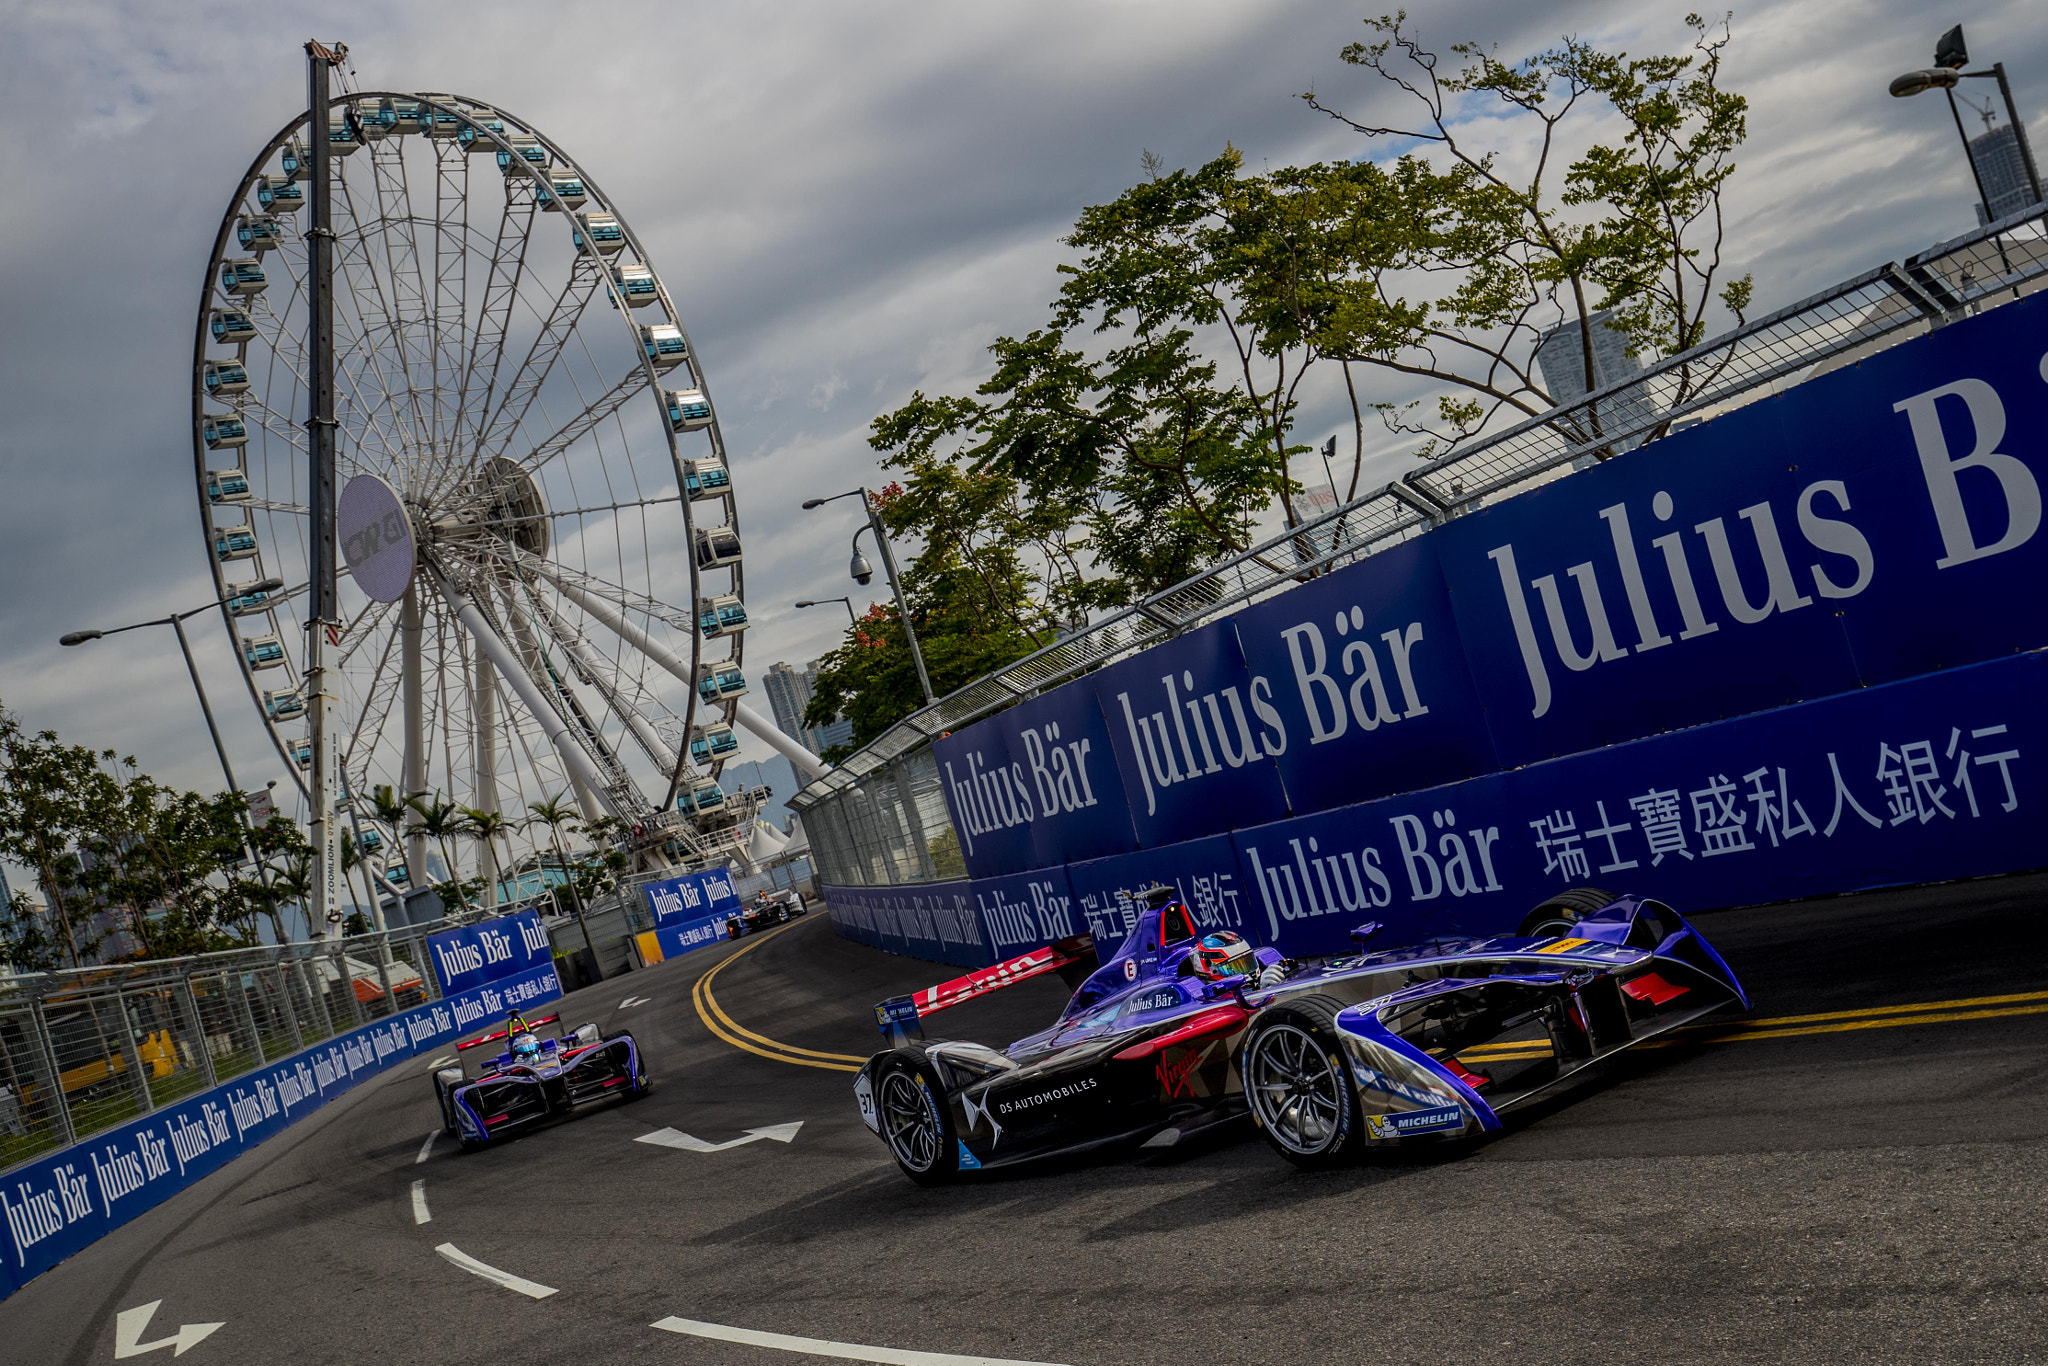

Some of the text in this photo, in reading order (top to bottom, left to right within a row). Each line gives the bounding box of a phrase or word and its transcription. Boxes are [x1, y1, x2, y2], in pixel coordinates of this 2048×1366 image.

[1308, 490, 1336, 507] UBS
[1487, 352, 2048, 718] Julius B
[1117, 605, 1430, 816] Julius Bär
[944, 721, 1098, 856] Julius Bär
[1529, 723, 2020, 883] 瑞士寶盛私人銀行
[650, 882, 702, 922] Julius Bär
[702, 876, 730, 909] Julius
[1246, 809, 1503, 942] Julius Bär
[928, 895, 964, 953] Julius
[953, 895, 983, 946] Bär
[976, 882, 1075, 960] Julius Bär
[1082, 871, 1246, 942] 瑞士寶人銀行
[435, 929, 513, 987] Julius Bär
[405, 1013, 437, 1050] Julius
[431, 1006, 452, 1033] Bär
[451, 989, 503, 1032] Julius Bär
[889, 1006, 913, 1016] MIHELIN
[1128, 993, 1174, 1015] Julius Bär
[369, 1022, 408, 1066] Julius Bär
[1156, 1047, 1203, 1098] Virgin
[227, 1078, 279, 1143] Julius Bär
[273, 1061, 316, 1118] Julius Bär
[1000, 1077, 1098, 1114] DS AUTOMOBILES
[1338, 1075, 1349, 1130] MICHELIN
[165, 1101, 231, 1177] Julius Bär
[1397, 1111, 1459, 1128] MICHELIN
[90, 1129, 171, 1219] Julius Bär
[0, 1163, 94, 1269] Julius Bär
